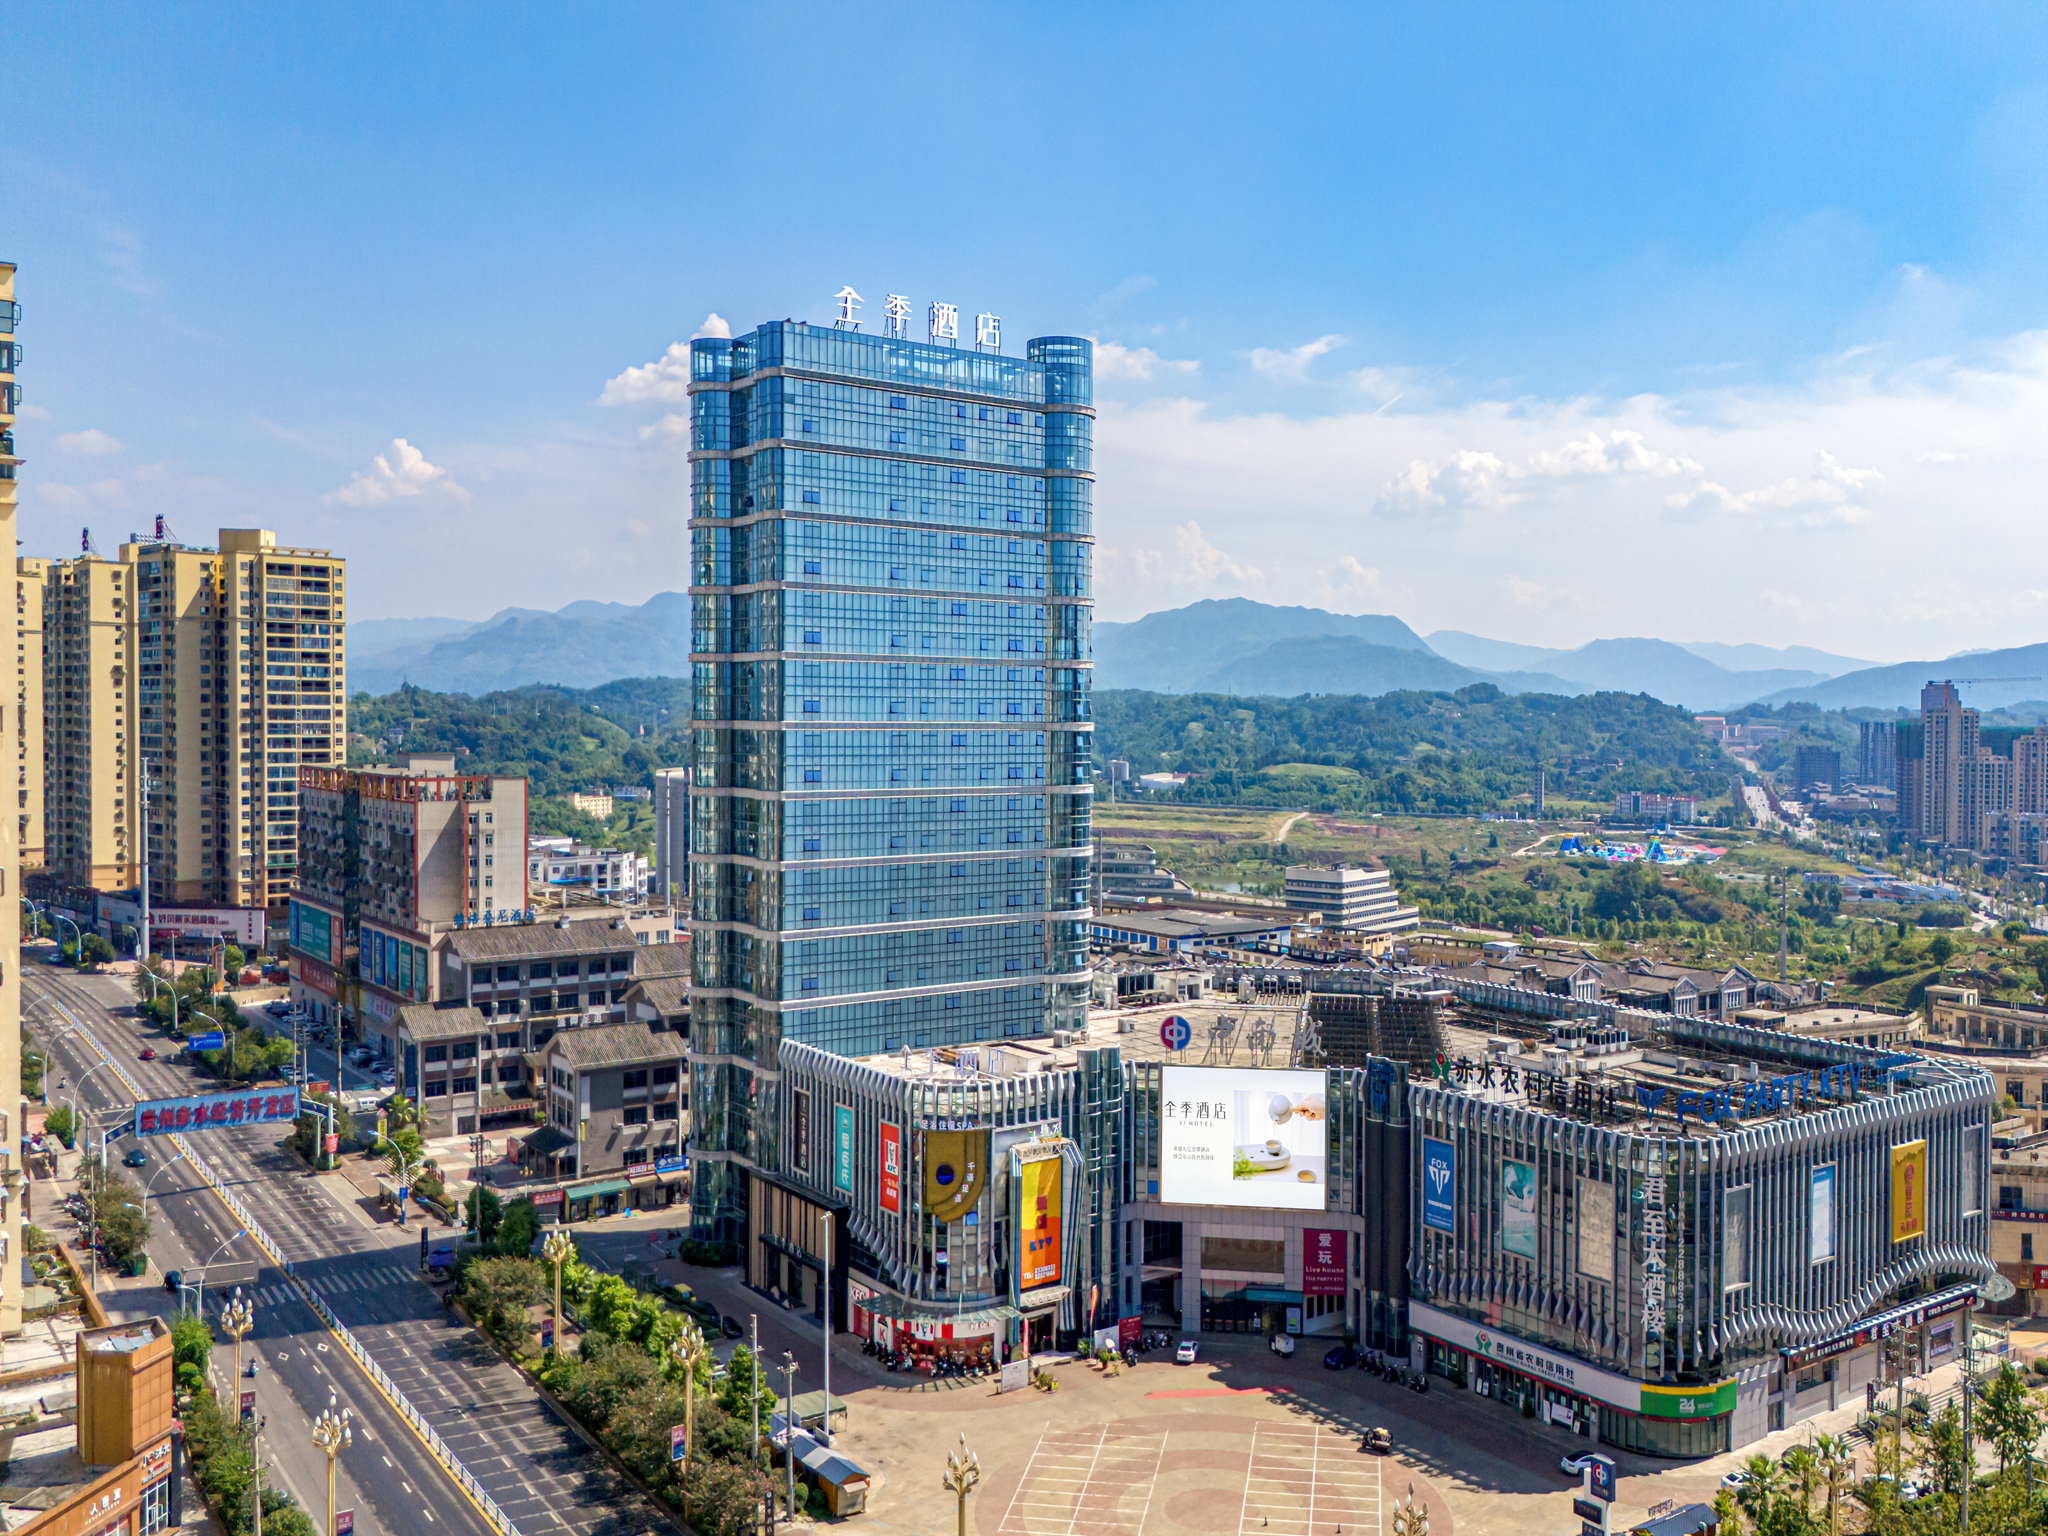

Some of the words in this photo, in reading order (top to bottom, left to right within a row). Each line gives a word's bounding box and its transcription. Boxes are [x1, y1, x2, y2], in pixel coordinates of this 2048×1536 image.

[834, 285, 1001, 348] 全季酒店
[1455, 1055, 1617, 1123] 赤水农村信用社
[141, 1094, 296, 1131] 贵州赤水经济开发区
[1164, 1101, 1226, 1119] 全季酒店
[887, 1164, 897, 1173] KFC
[1431, 1158, 1447, 1169] FOX
[1030, 1236, 1053, 1252] KTV
[1318, 1233, 1332, 1265] 爱玩
[1641, 1177, 1667, 1334] 君至大酒楼
[850, 1286, 866, 1300] KFC
[1496, 1341, 1574, 1380] 贵州省农村信用社
[1520, 1361, 1537, 1371] RURAL
[1538, 1368, 1556, 1378] CREDIT
[1557, 1375, 1574, 1385] UNION
[1679, 1398, 1695, 1413] 24
